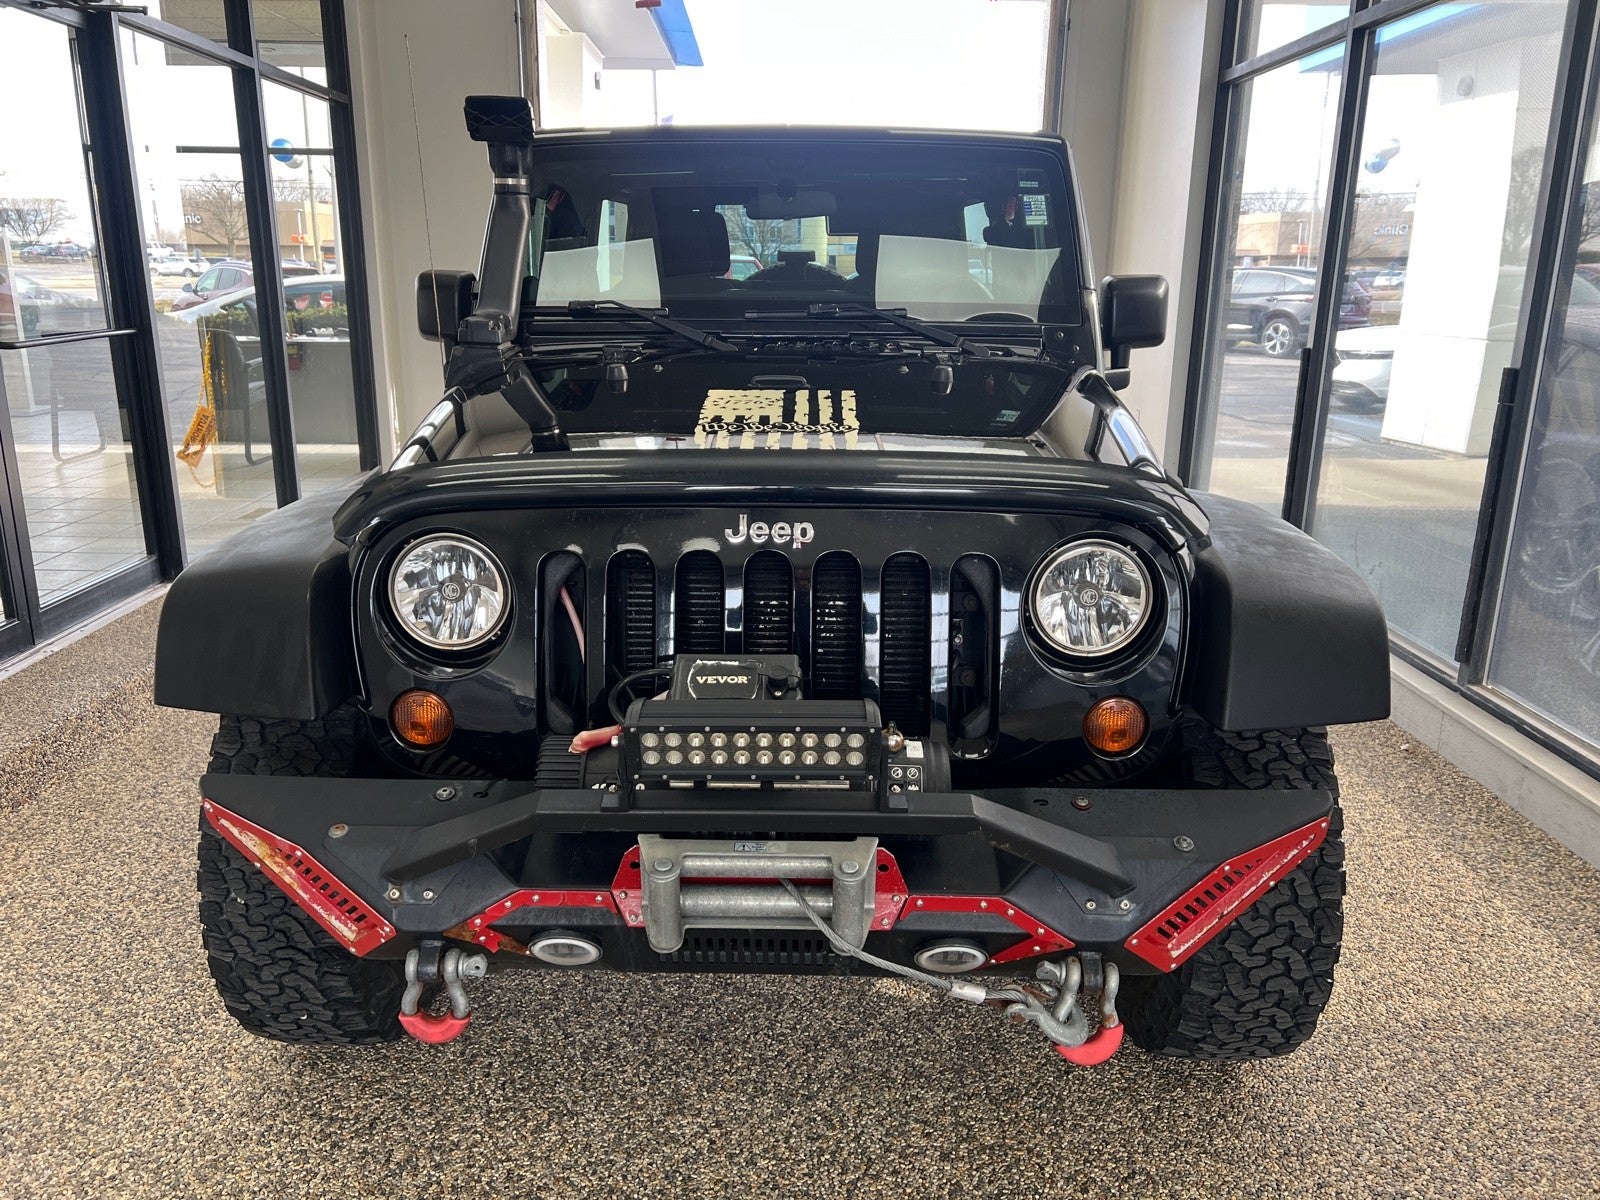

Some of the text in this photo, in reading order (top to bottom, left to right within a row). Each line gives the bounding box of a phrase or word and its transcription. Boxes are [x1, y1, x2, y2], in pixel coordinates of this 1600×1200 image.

[703, 421, 857, 434] We the People
[724, 513, 815, 549] Jeep
[444, 584, 457, 598] KC
[1083, 591, 1096, 604] KC
[696, 675, 748, 684] VEVOR
